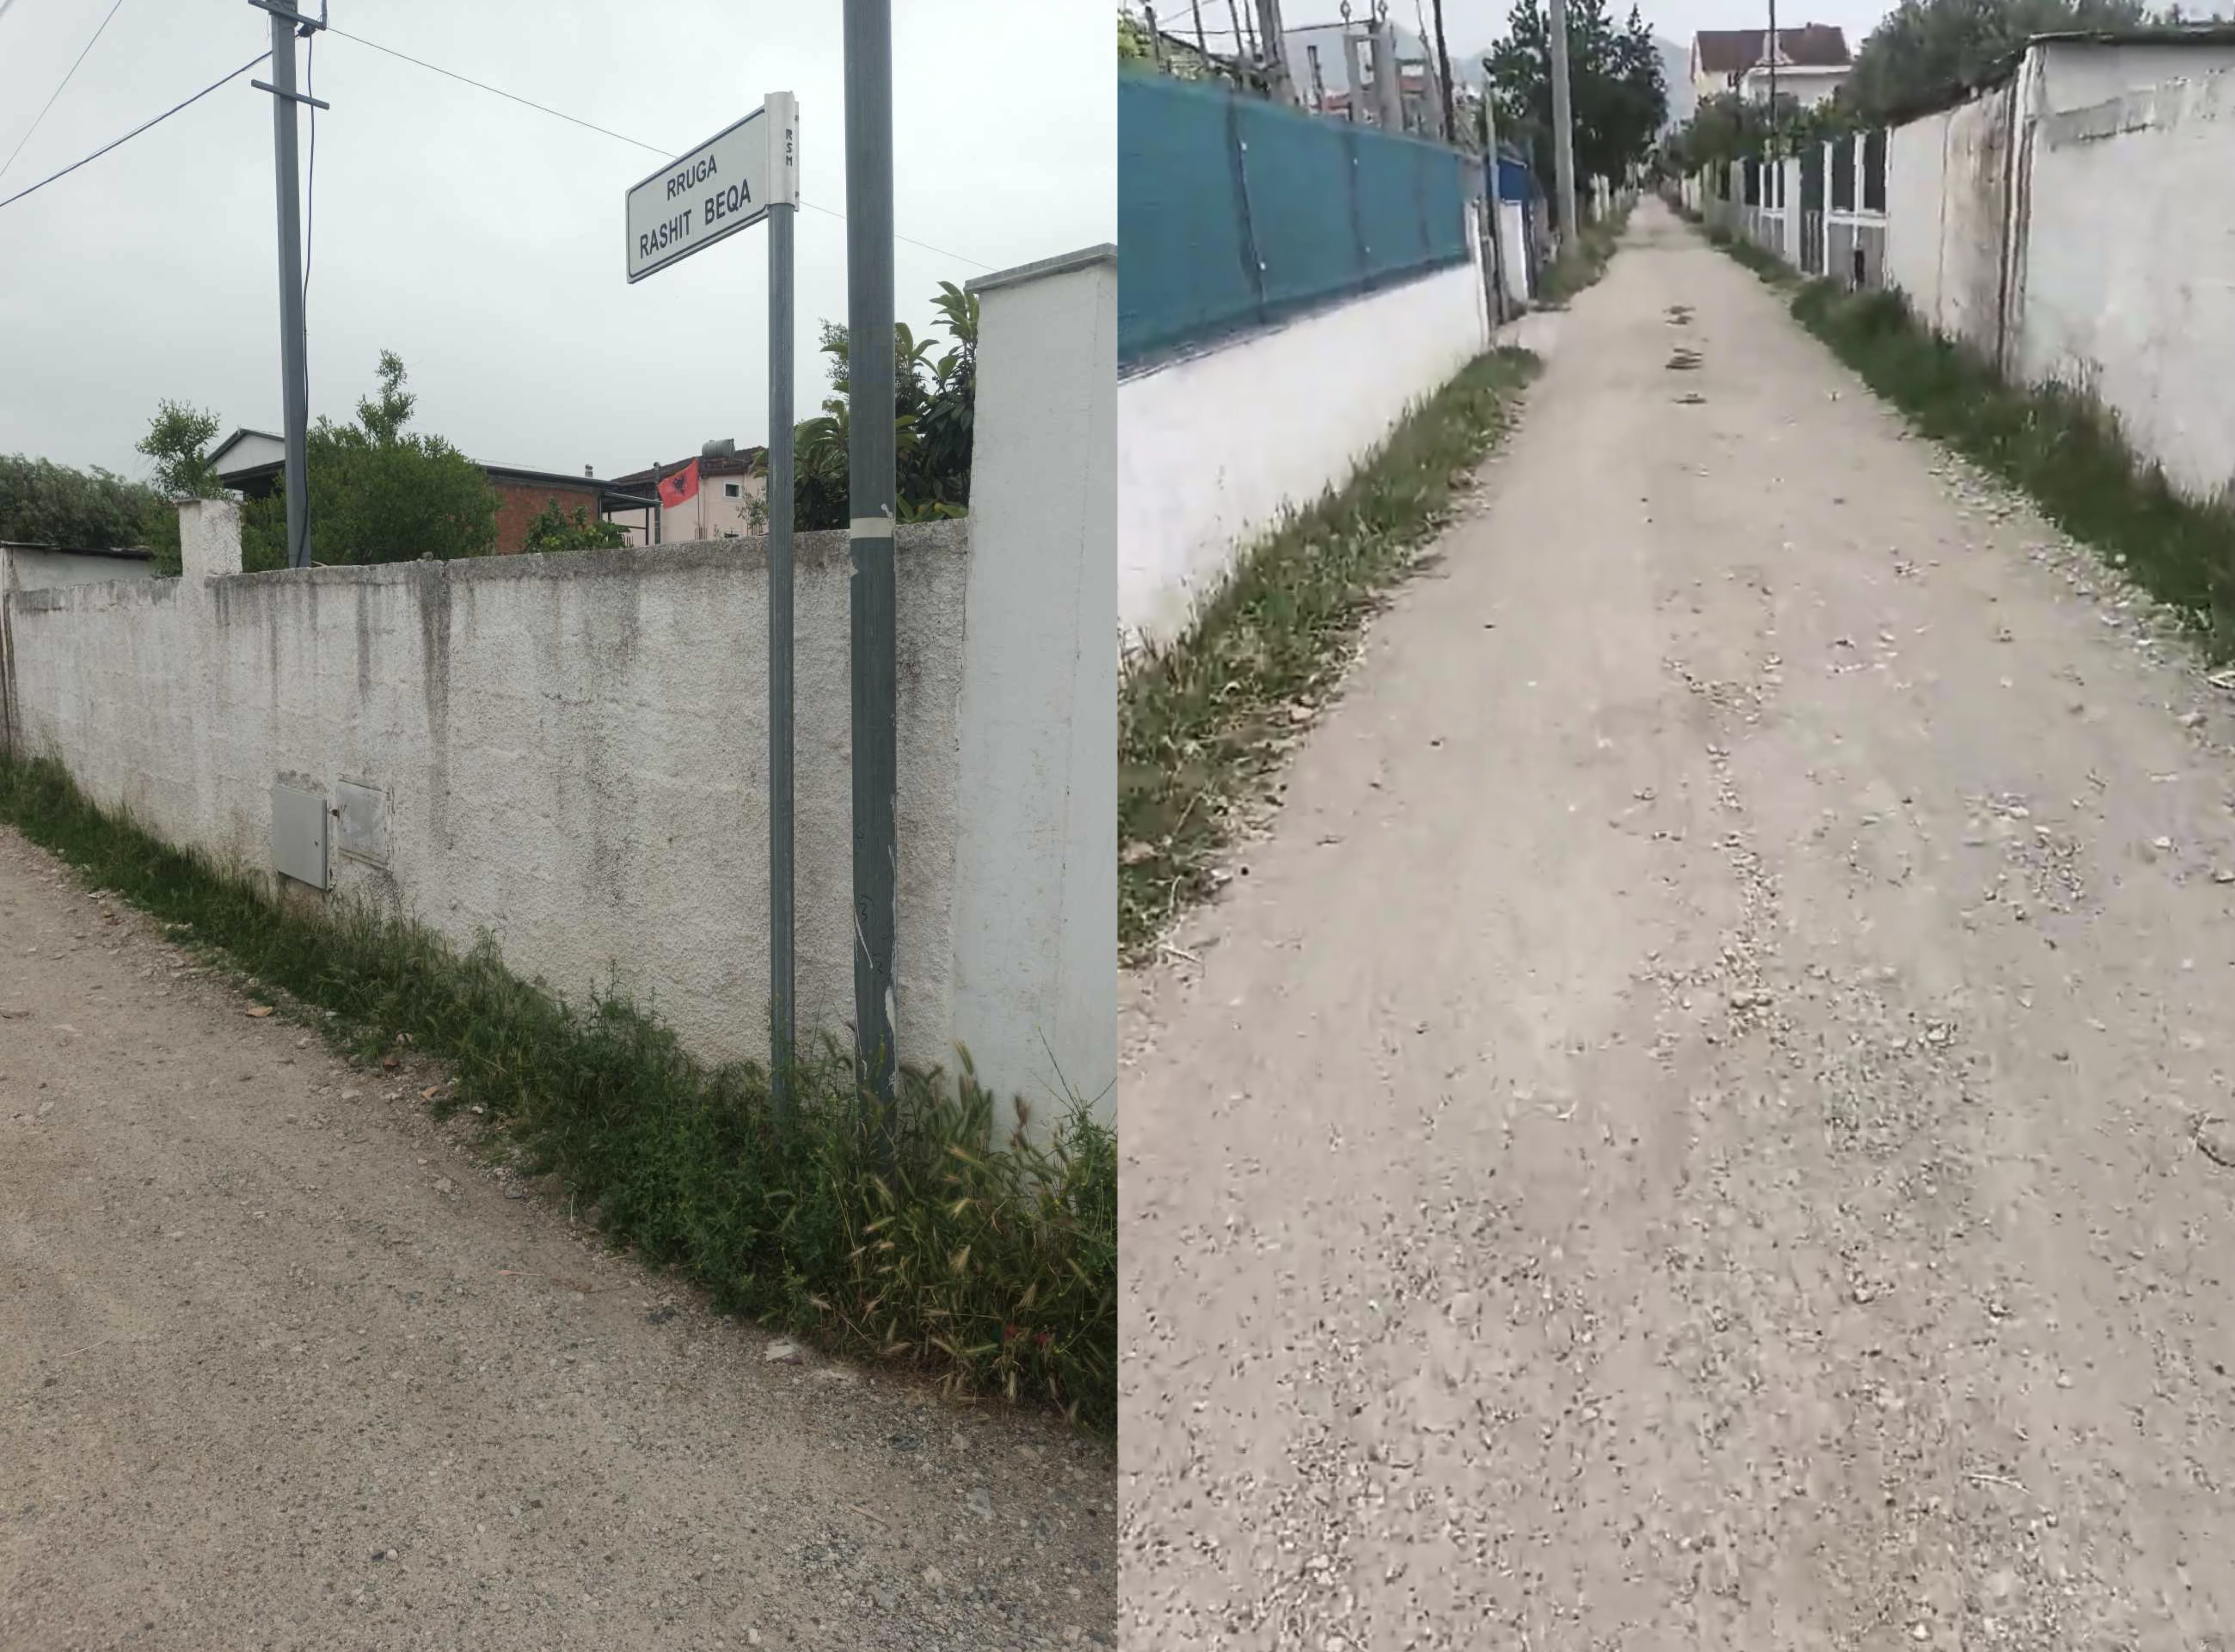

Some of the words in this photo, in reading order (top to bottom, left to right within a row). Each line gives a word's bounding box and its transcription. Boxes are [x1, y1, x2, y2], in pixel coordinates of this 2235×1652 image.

[667, 155, 717, 200] RRUGA
[640, 210, 692, 259] RASHIT
[705, 179, 751, 225] BEQA
